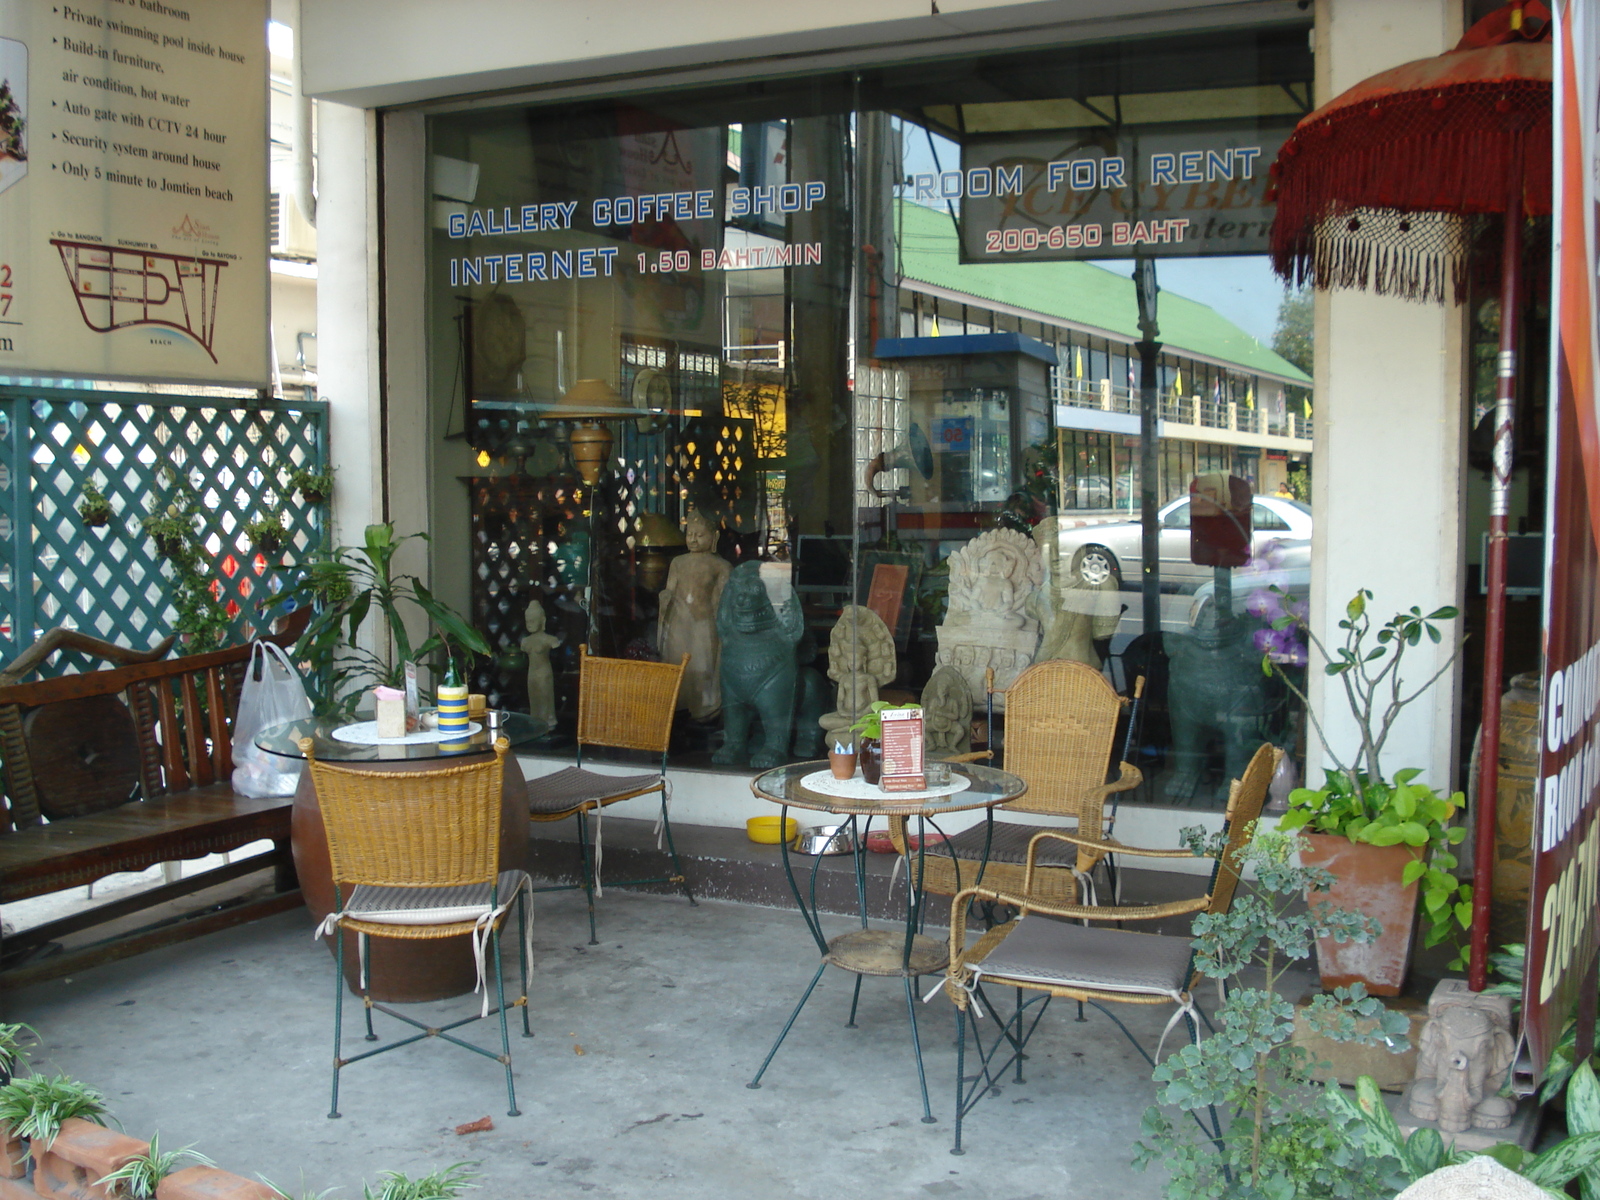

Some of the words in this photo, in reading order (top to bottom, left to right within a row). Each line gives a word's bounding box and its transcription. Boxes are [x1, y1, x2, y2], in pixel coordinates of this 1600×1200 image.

[140, 0, 190, 21] bathroom
[63, 6, 103, 28] Private
[106, 18, 159, 44] swimming
[162, 34, 184, 51] pool
[187, 38, 216, 57] inside
[219, 46, 245, 64] house
[62, 37, 109, 60] Build-in
[112, 49, 165, 74] furniture,
[62, 70, 78, 84] air
[83, 75, 137, 97] condition,
[140, 86, 157, 101] hot
[161, 93, 190, 108] water
[62, 100, 90, 117] Auto
[94, 107, 117, 123] gate
[121, 112, 144, 128] with
[148, 117, 182, 135] CCTV
[185, 124, 199, 139] 24
[203, 128, 227, 144] hour
[62, 130, 108, 153] Security
[112, 141, 148, 158] system
[152, 147, 189, 167] around
[192, 155, 221, 172] house
[62, 161, 90, 181] Only
[94, 167, 101, 179] 5
[106, 171, 143, 188] minute
[147, 178, 157, 189] to
[160, 178, 201, 198] Jomtien
[204, 186, 233, 202] beach
[914, 165, 1024, 201] ROOM
[1047, 157, 1127, 193] FOR
[1150, 147, 1261, 186] RENT
[448, 201, 578, 238] GALLERY
[592, 190, 714, 227] COFFEE
[730, 181, 826, 217] SHOP
[75, 232, 103, 243] BANGKOK
[117, 238, 149, 250] SUKHUMVIT
[202, 249, 210, 257] Go
[216, 251, 238, 261] RAYONG
[985, 224, 1103, 255] 200-650
[1111, 219, 1190, 247] BAHT
[450, 247, 619, 287] INTERNET
[637, 250, 690, 274] 1.50
[700, 242, 823, 271] BAHT/MIN
[150, 338, 172, 346] BEACH
